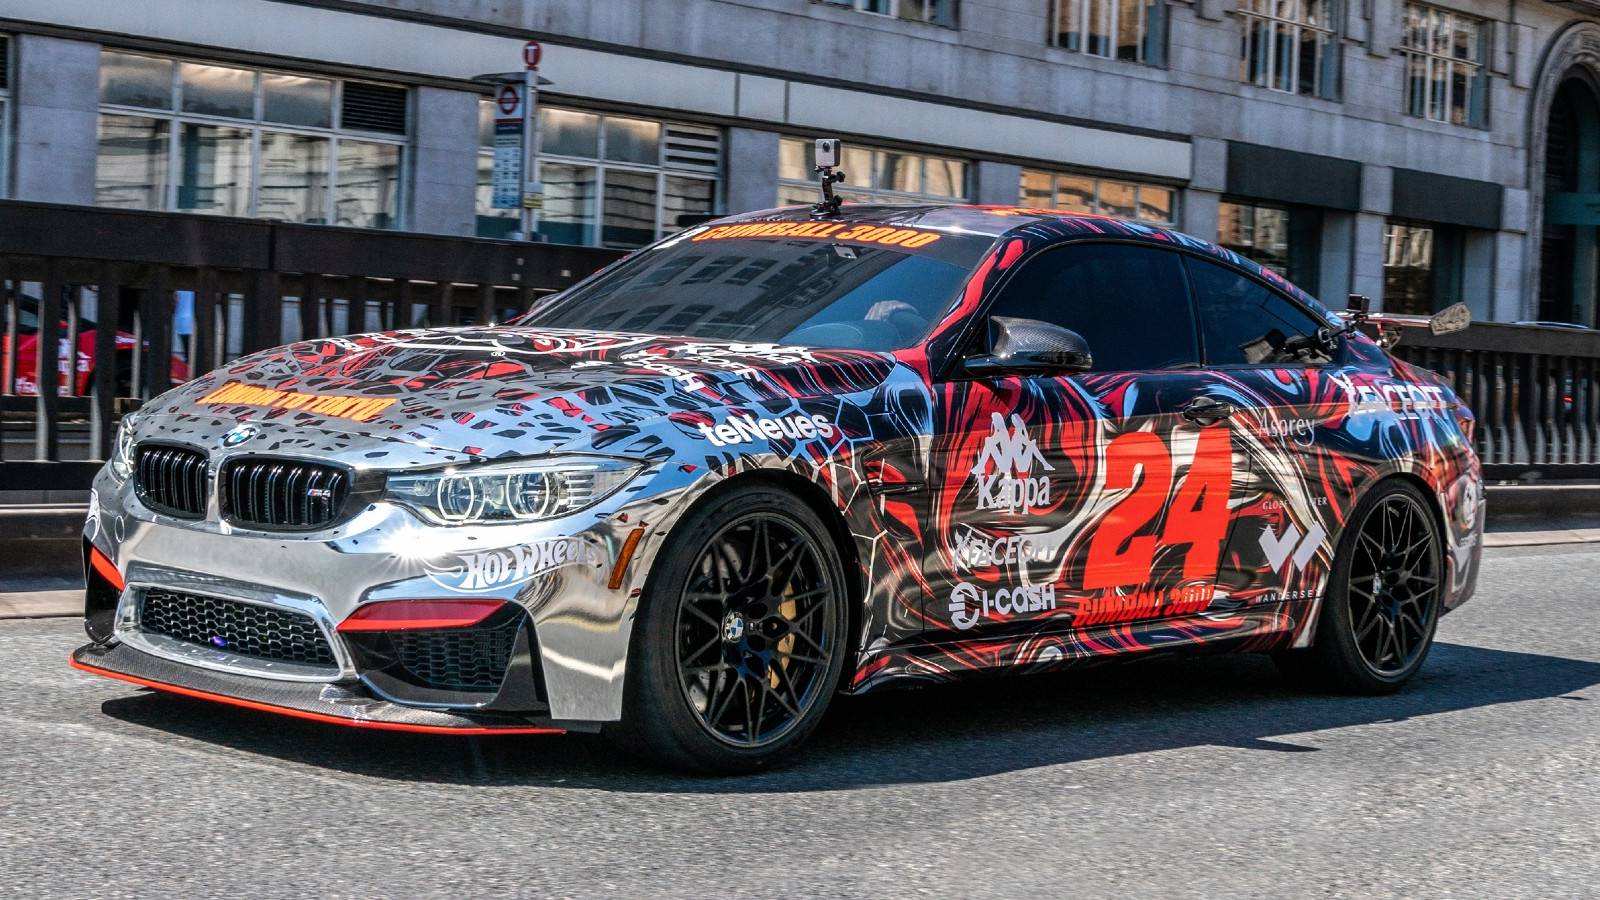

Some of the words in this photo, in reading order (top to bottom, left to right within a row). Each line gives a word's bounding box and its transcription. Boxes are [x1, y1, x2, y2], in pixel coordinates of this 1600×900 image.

[691, 222, 848, 242] GUMBALL
[835, 224, 941, 249] 3000
[271, 391, 315, 410] TO
[300, 395, 398, 422] TOKYO
[697, 414, 836, 447] teNeues
[1258, 411, 1316, 447] Asprey
[976, 473, 1051, 515] Kappa
[1083, 428, 1233, 590] 24
[1255, 588, 1321, 603] WANDERSE
